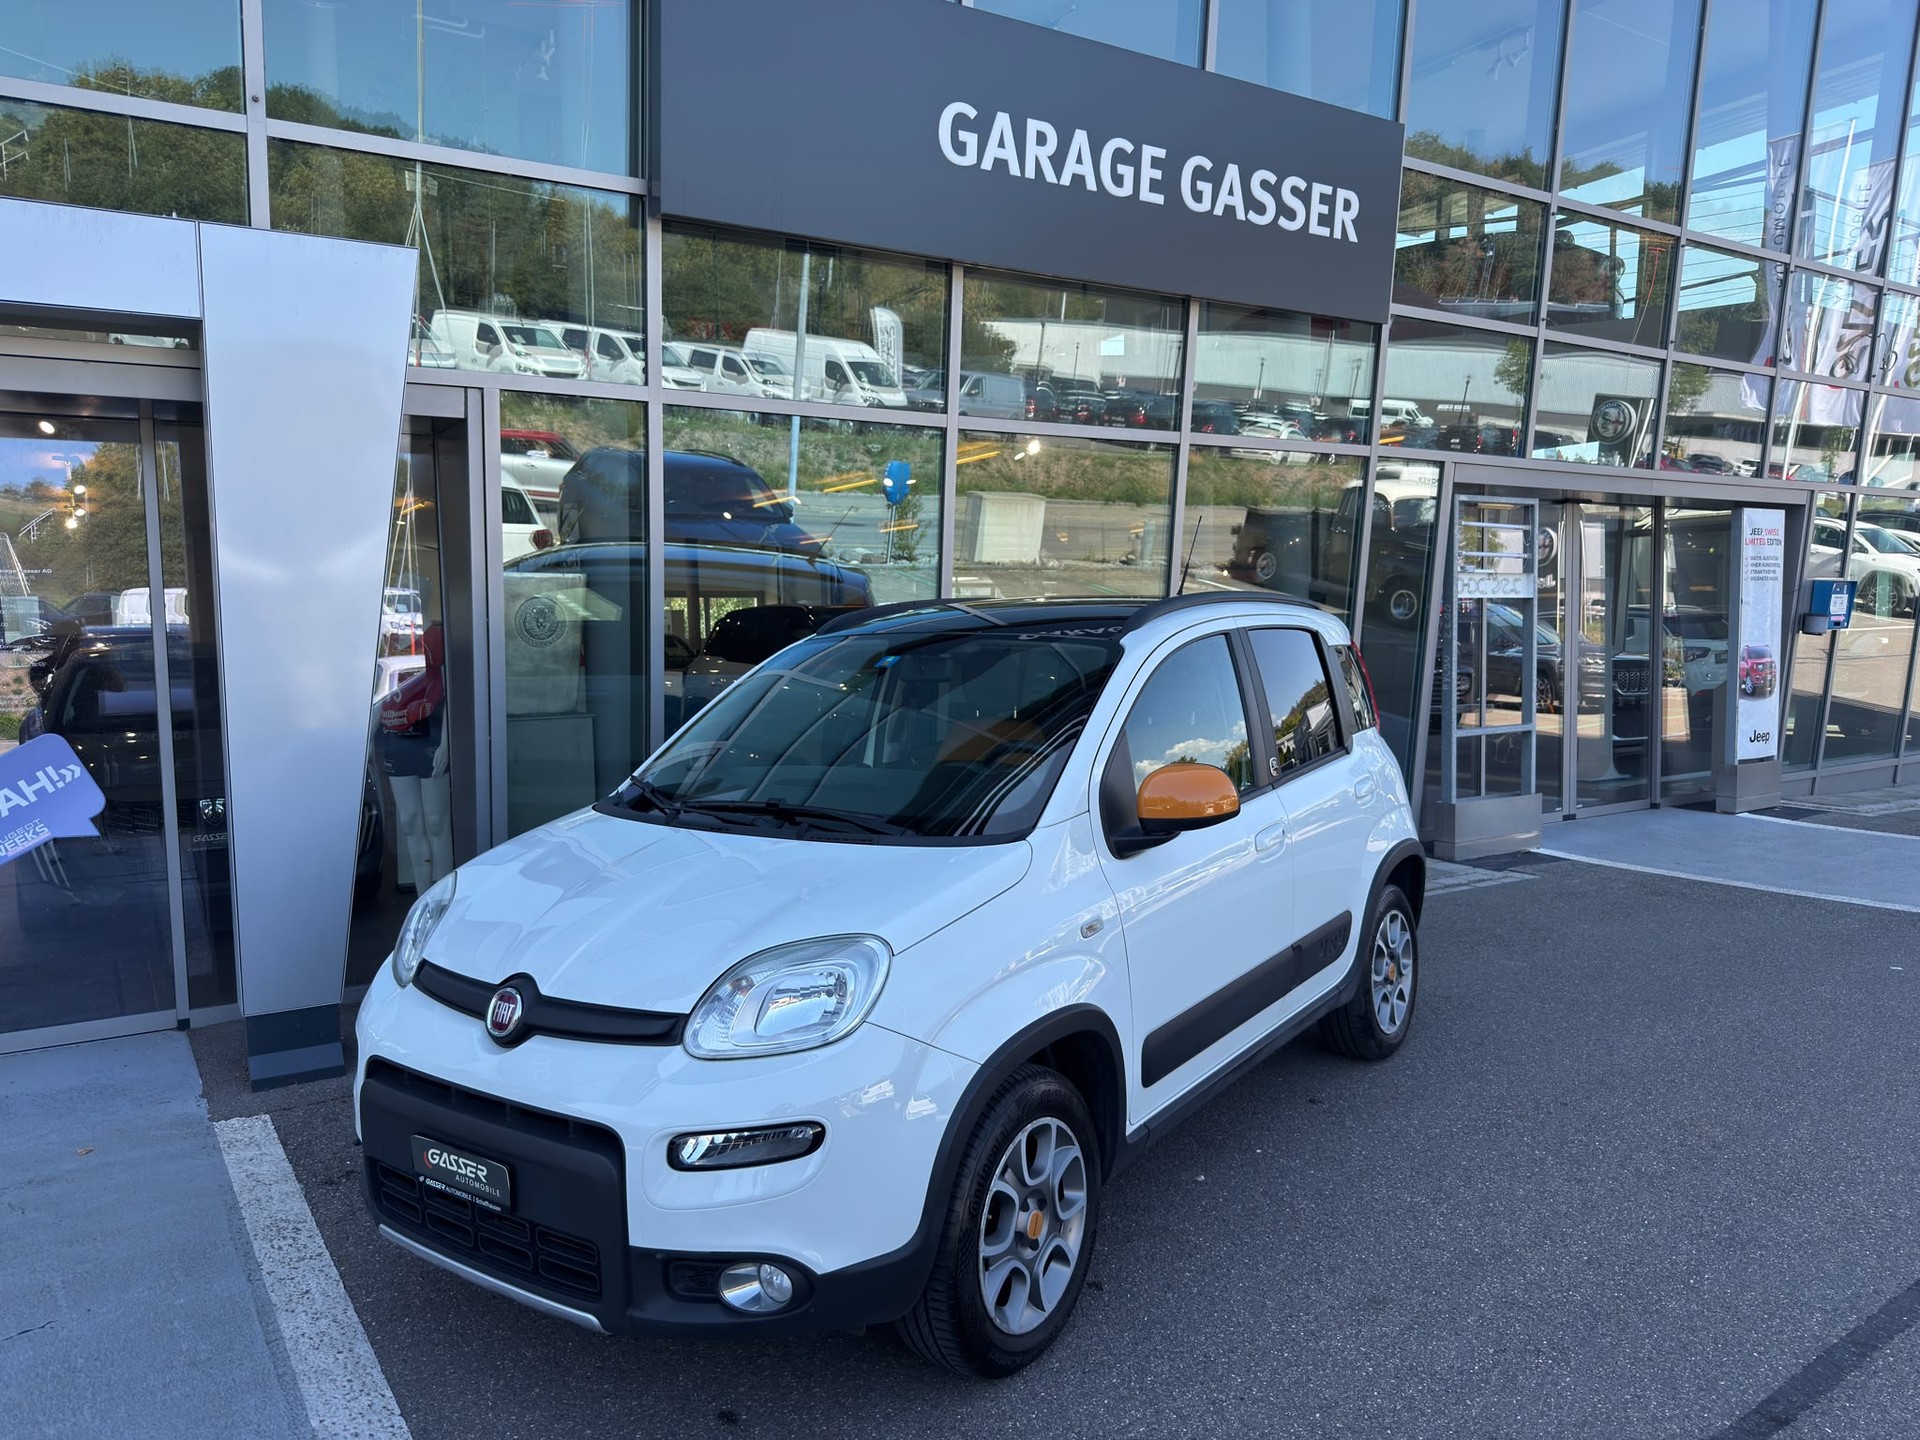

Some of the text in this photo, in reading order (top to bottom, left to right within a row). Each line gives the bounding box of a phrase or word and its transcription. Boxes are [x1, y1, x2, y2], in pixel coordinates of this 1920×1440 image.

[938, 101, 1360, 243] GARAGE GASSER
[1749, 729, 1770, 744] Jeep
[193, 833, 229, 842] GASSE
[493, 1000, 515, 1024] FIAT
[428, 1148, 488, 1183] GASSER
[426, 1178, 502, 1212] GASSER AUTOMOBILE Schaffhausen
[455, 1174, 501, 1197] AUTOMOBILE
